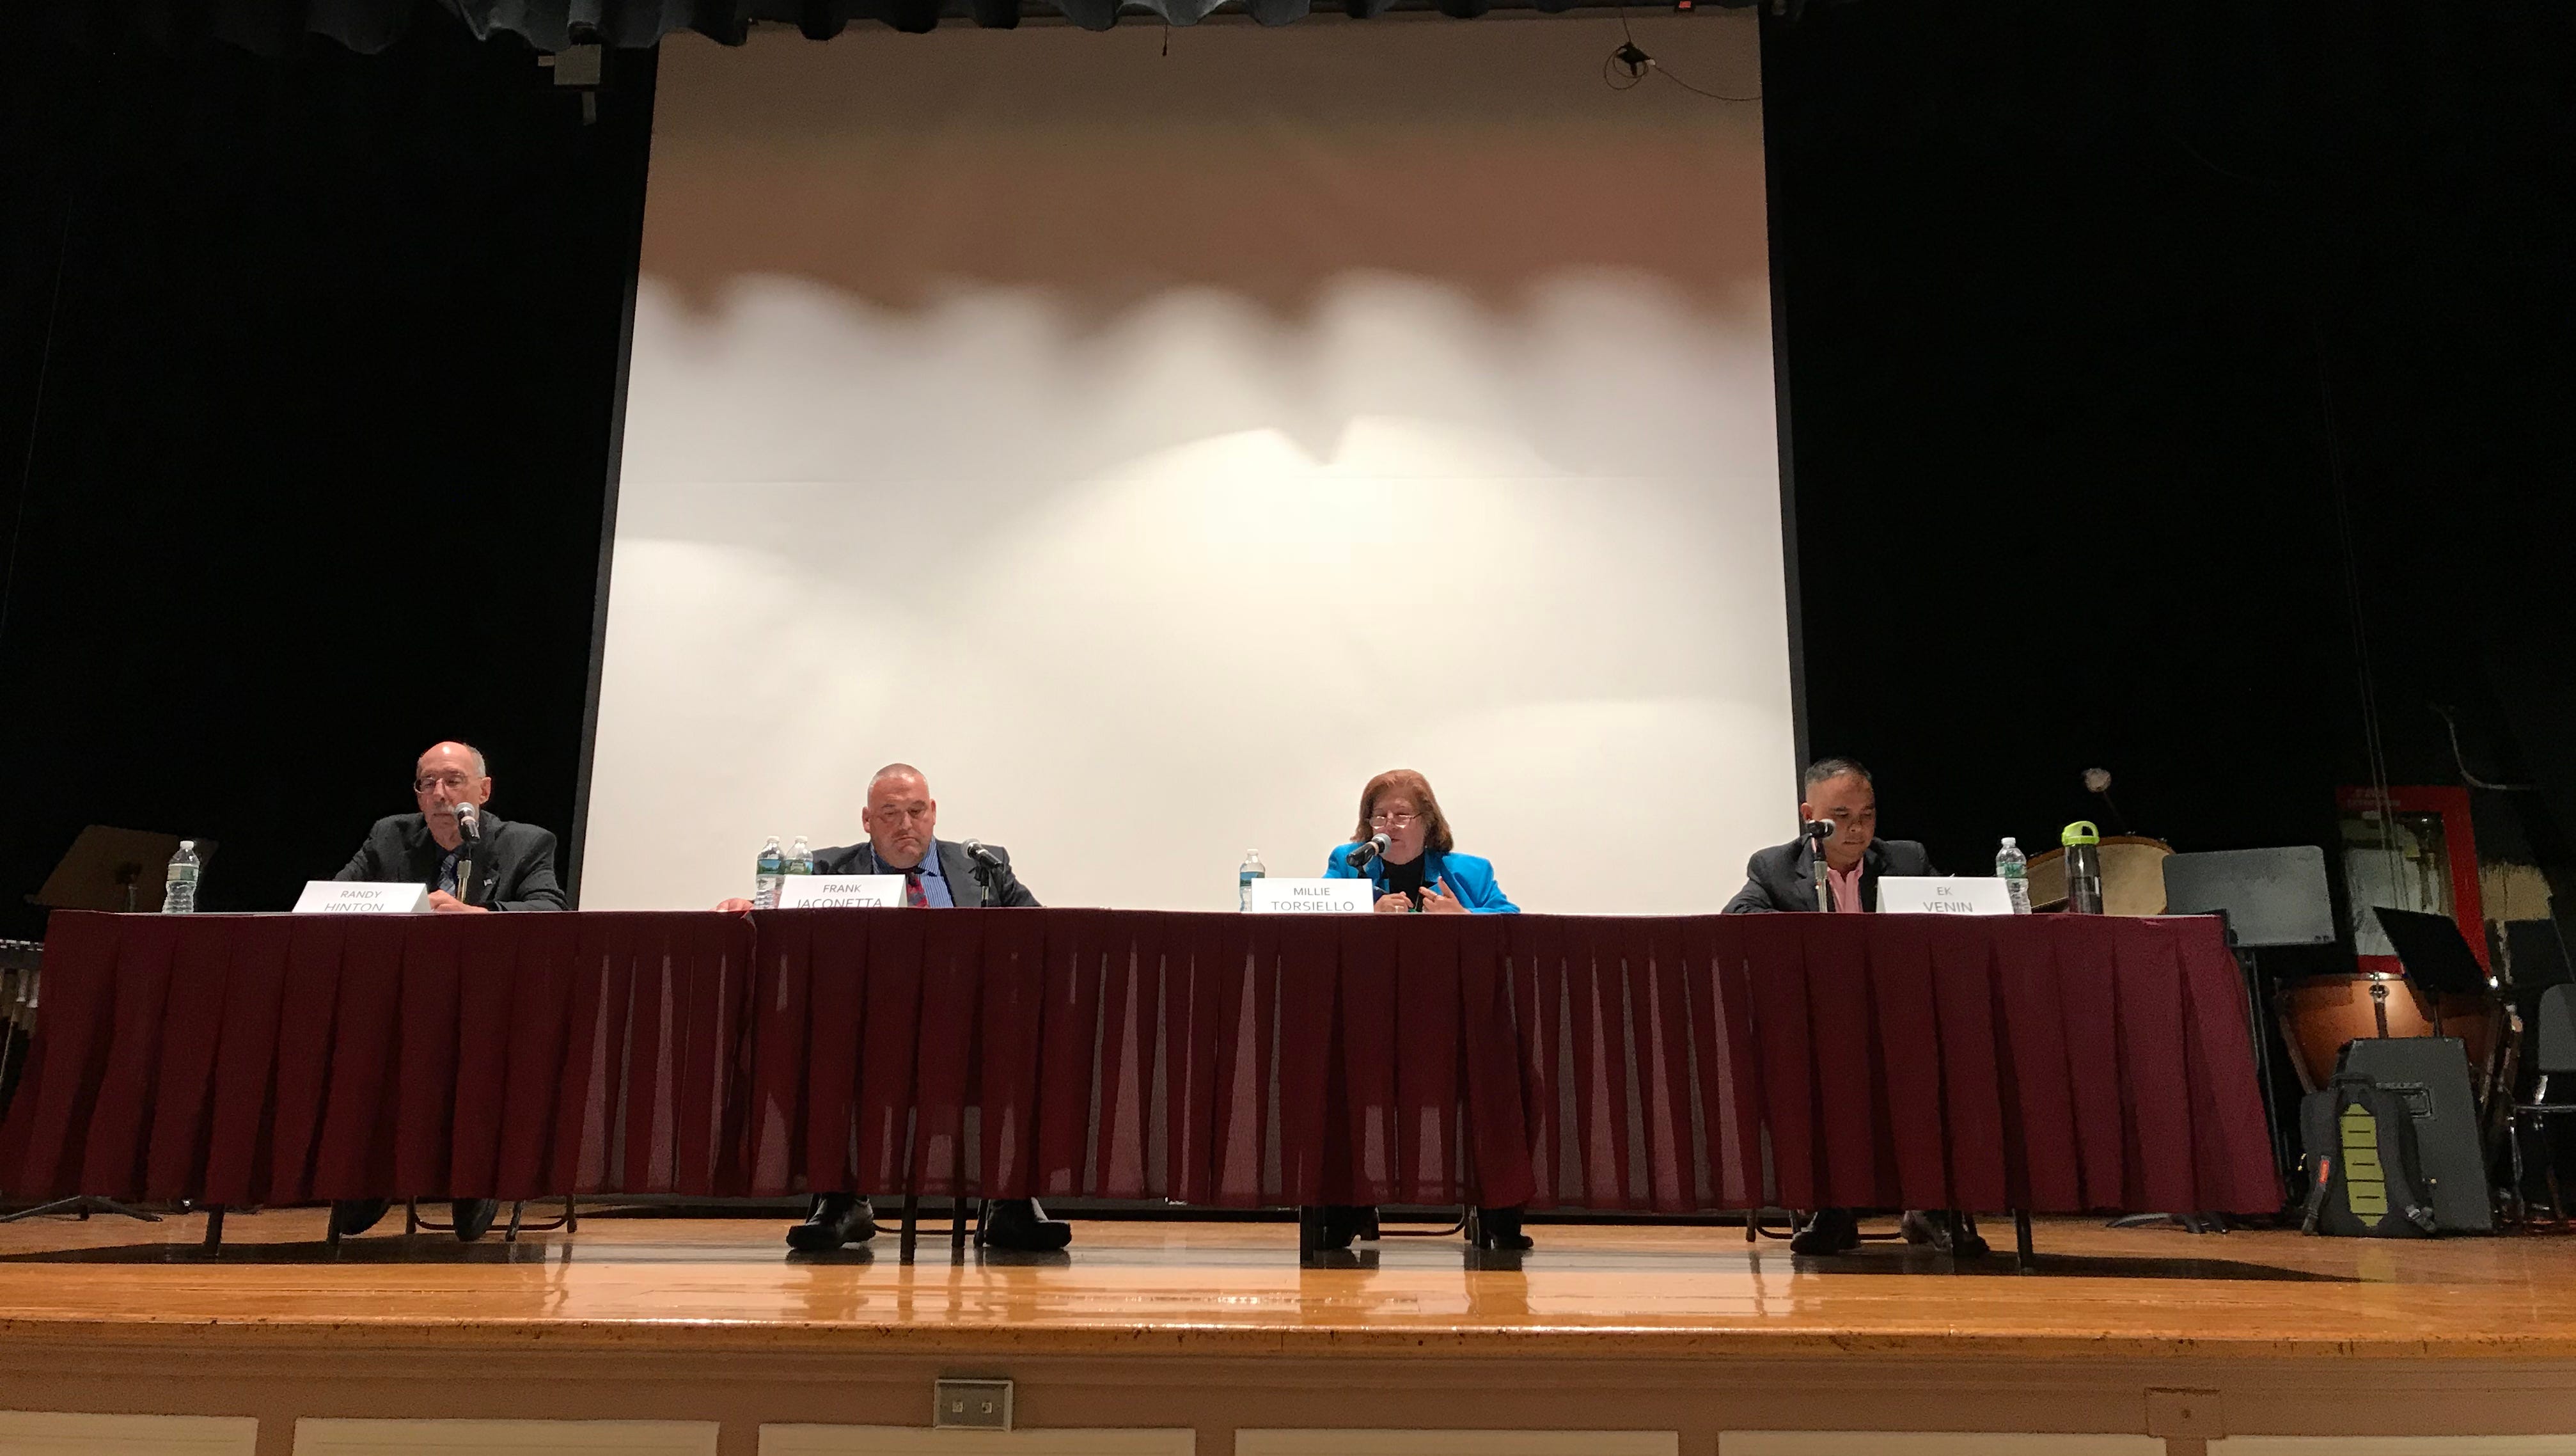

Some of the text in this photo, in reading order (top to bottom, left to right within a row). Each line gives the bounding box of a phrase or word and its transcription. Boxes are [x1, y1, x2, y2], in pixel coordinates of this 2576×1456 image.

[822, 884, 862, 893] FRANK
[1293, 887, 1331, 896] MILLIE
[1936, 886, 1953, 896] EK
[340, 890, 382, 898] RANDY
[324, 903, 384, 912] HINTON
[1271, 901, 1355, 911] TORSIELLO
[1922, 901, 1974, 912] VENIN
